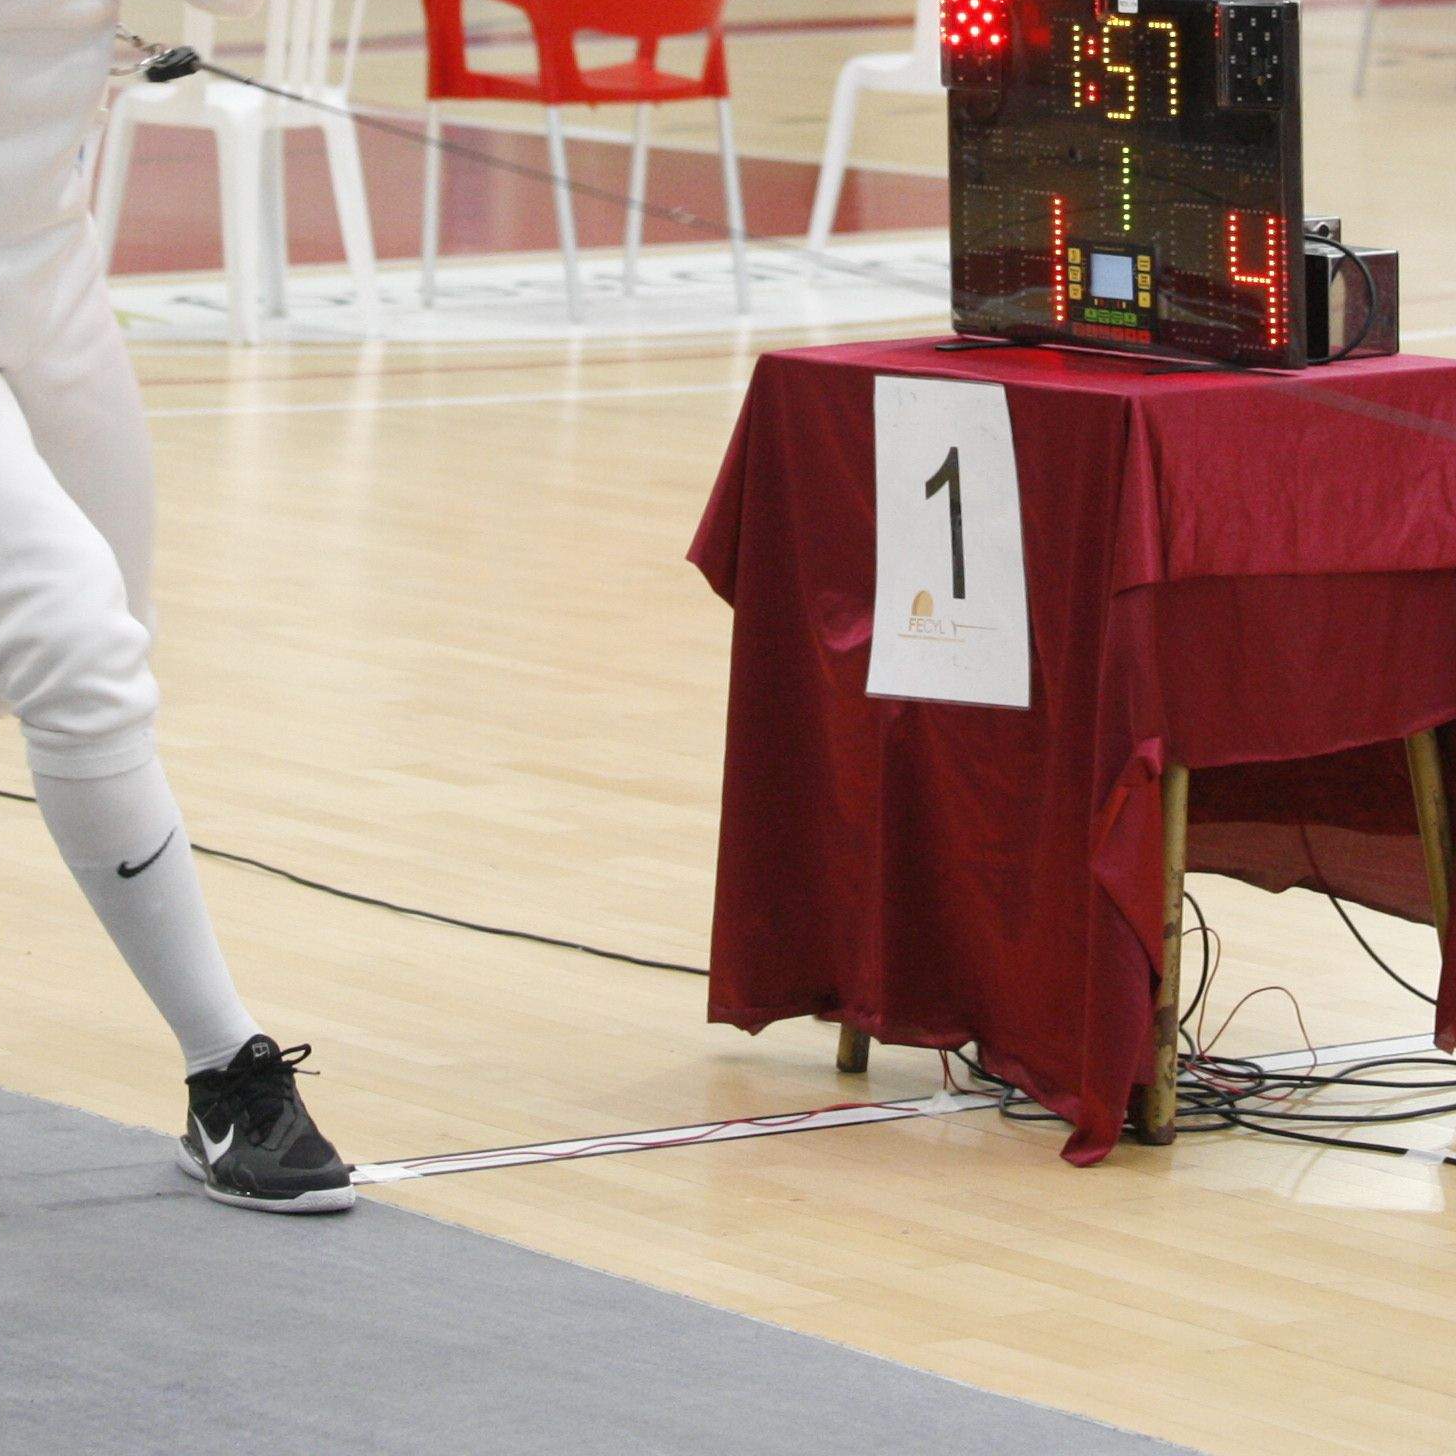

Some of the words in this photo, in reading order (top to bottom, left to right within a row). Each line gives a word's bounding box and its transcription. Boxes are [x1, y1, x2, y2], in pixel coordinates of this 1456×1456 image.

[1072, 15, 1179, 120] 1:57
[1227, 212, 1282, 346] 4
[925, 446, 966, 599] 1
[908, 616, 946, 634] FECYL
